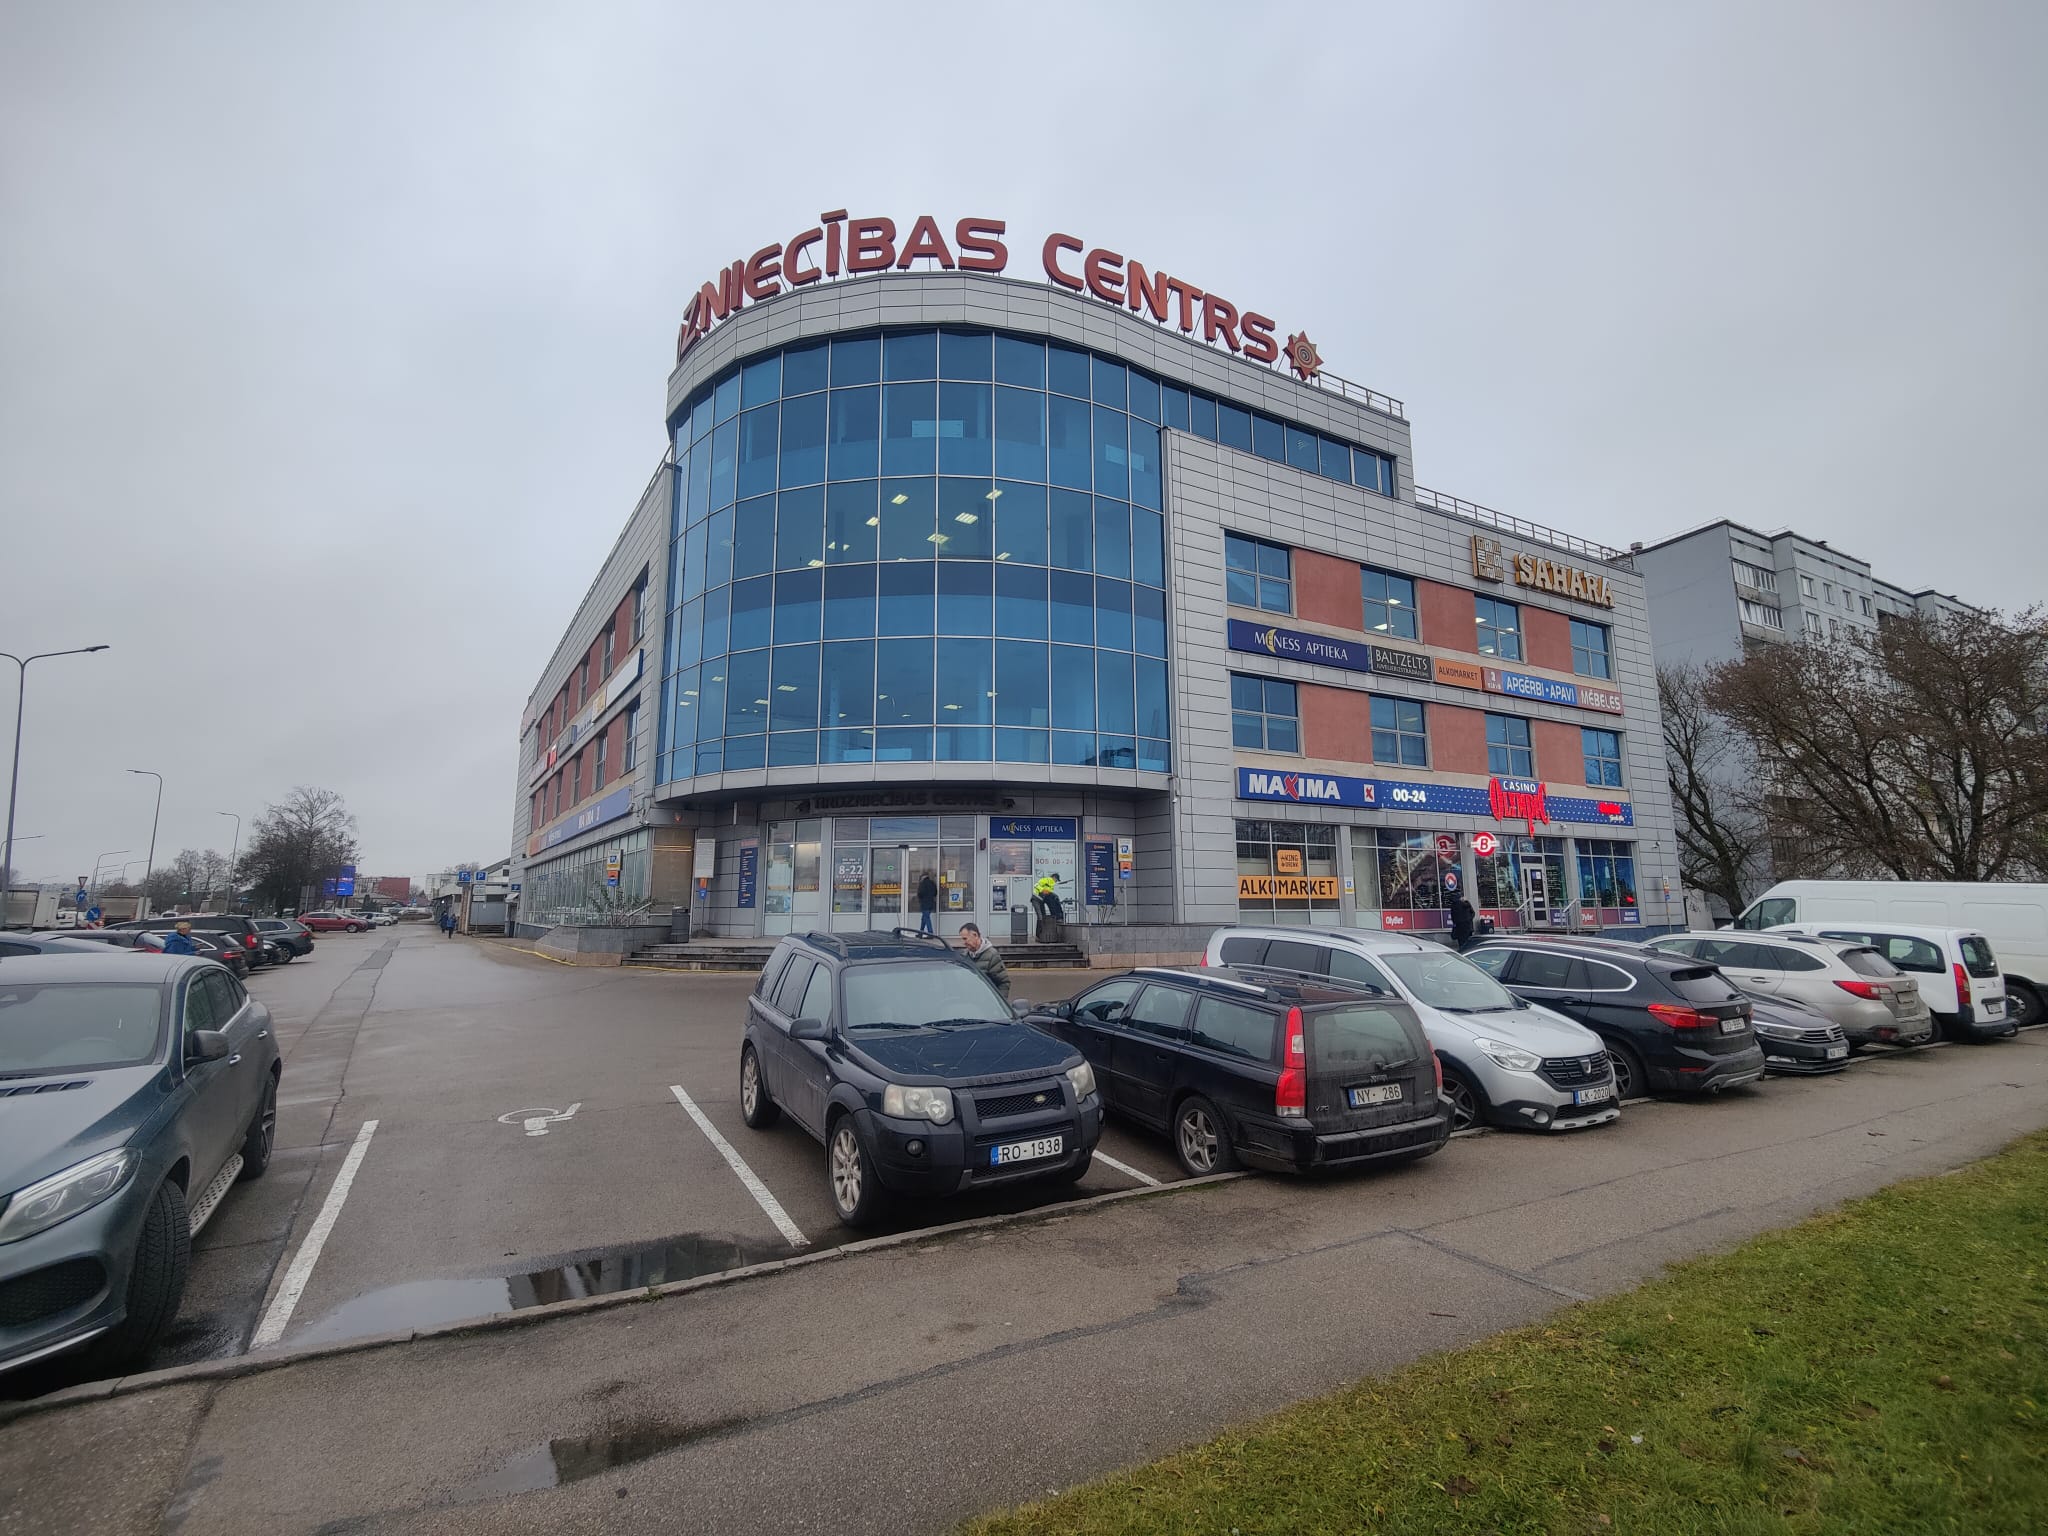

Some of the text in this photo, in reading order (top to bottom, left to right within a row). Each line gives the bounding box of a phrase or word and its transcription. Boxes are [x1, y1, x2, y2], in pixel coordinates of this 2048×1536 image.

[676, 208, 1280, 365] ZNIECĪBAS CENTRS
[1514, 552, 1616, 608] SAHARA
[1305, 641, 1348, 661] APTIEKA
[1376, 649, 1428, 670] BALTZELTS
[1438, 665, 1478, 680] ALKOMARKET
[1550, 684, 1575, 702] APAVI
[1248, 773, 1341, 800] MAXIMA
[1392, 788, 1427, 803] 00-24
[1503, 780, 1536, 793] CASINO
[1035, 825, 1063, 833] APTIEKA
[839, 865, 863, 875] 8-22
[1240, 879, 1334, 896] ALKOMARKET
[1001, 1138, 1060, 1161] RO-1938
